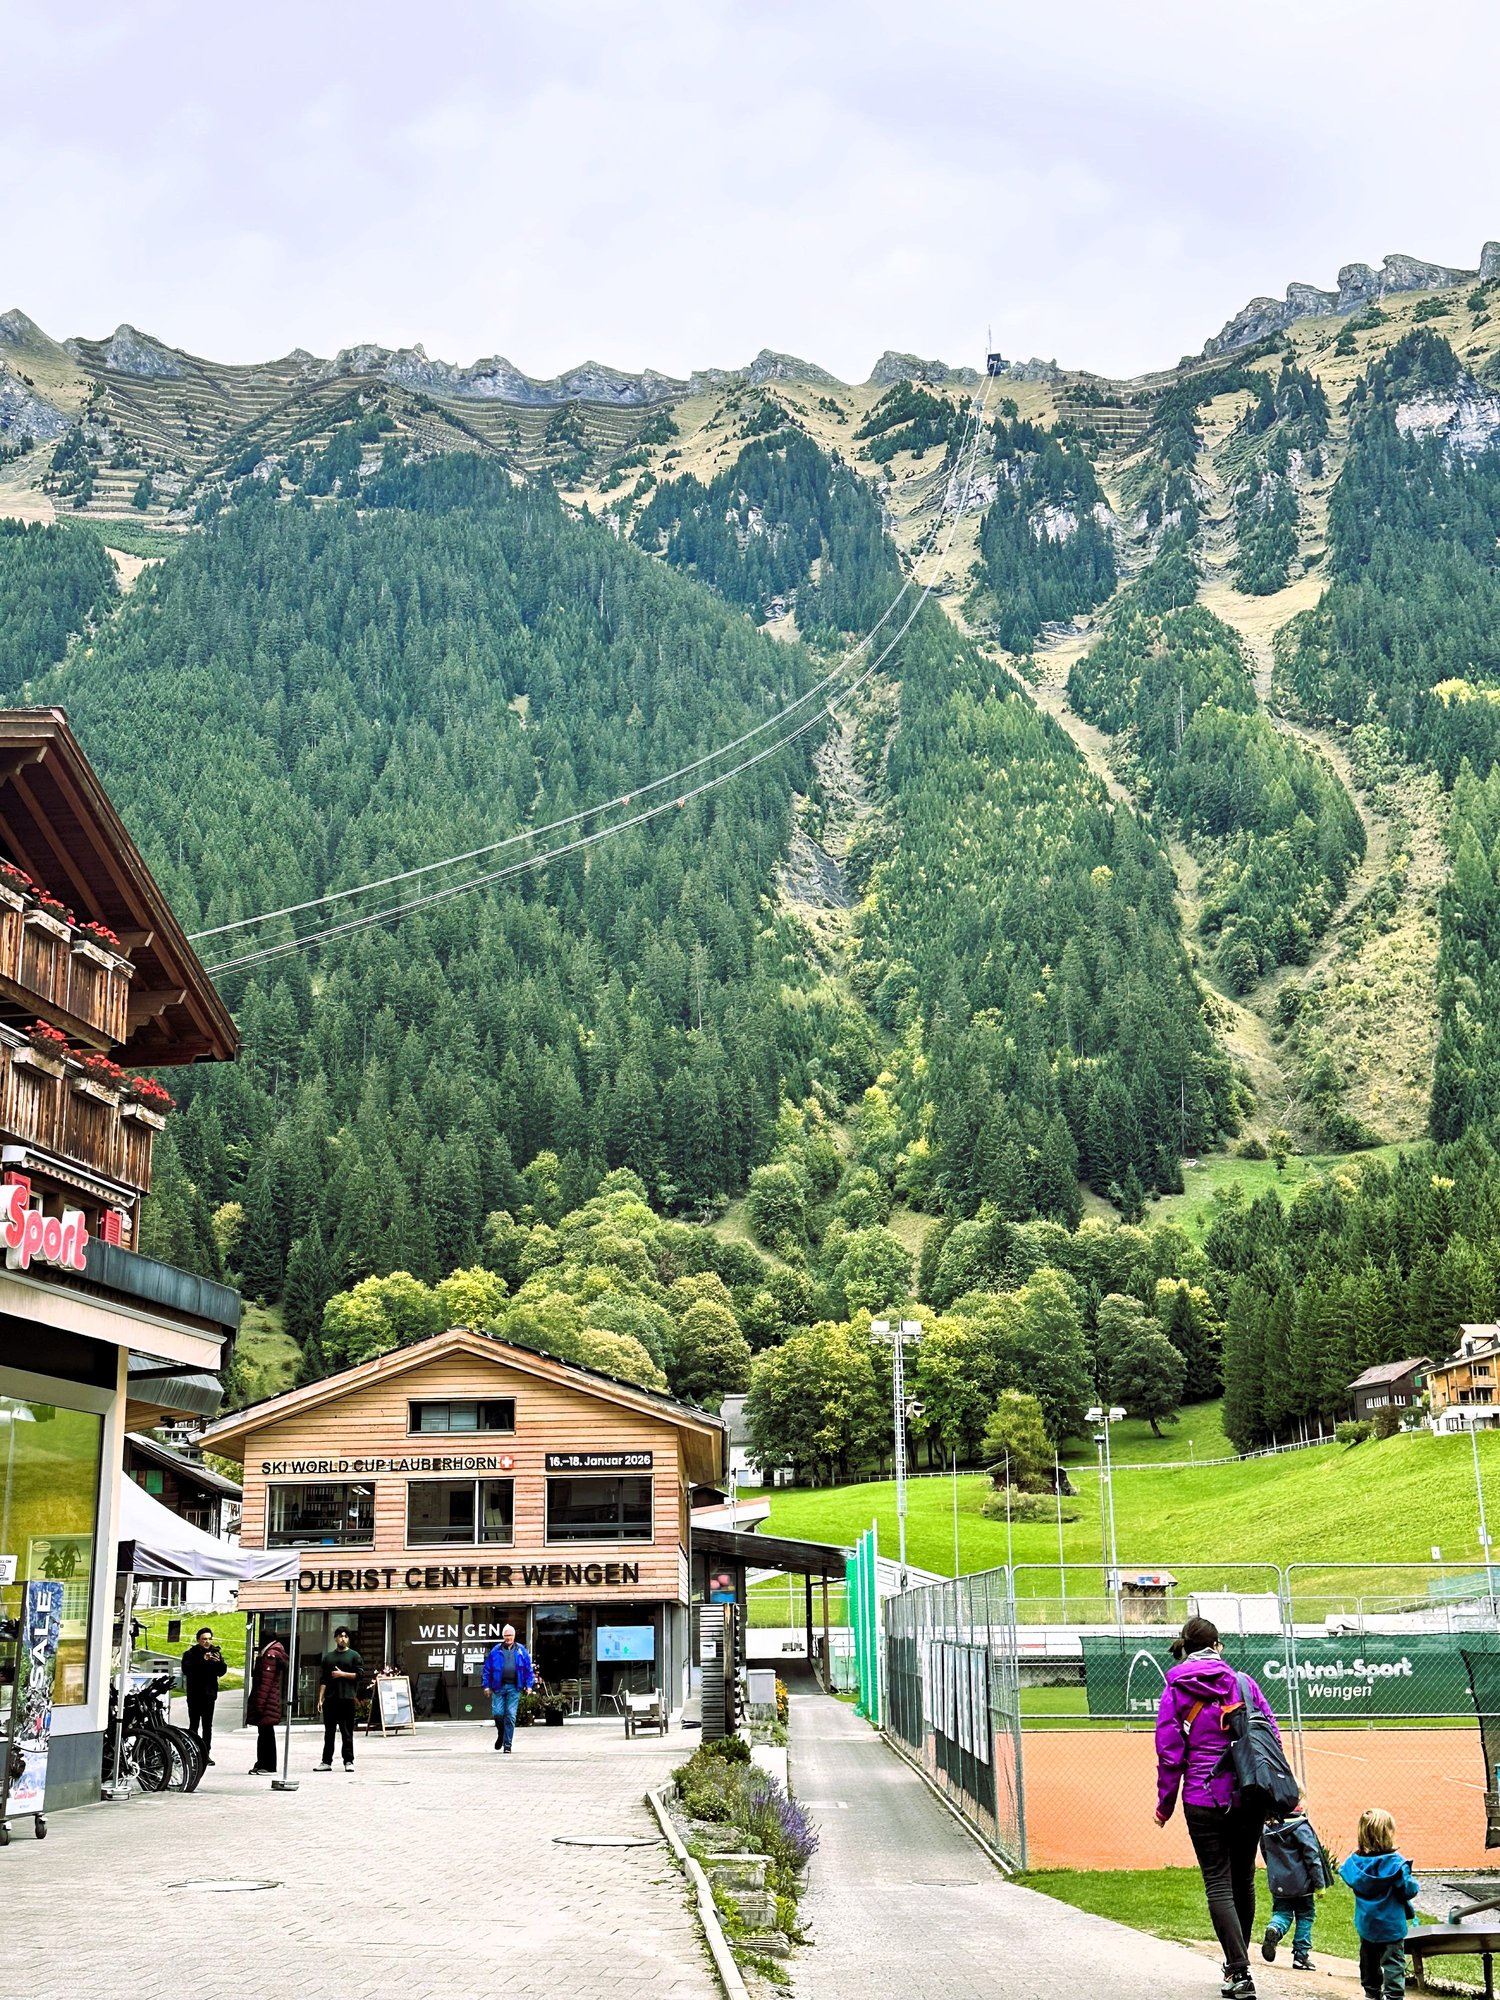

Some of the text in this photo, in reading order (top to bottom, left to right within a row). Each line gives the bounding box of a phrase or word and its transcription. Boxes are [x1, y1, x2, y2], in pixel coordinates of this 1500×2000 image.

[4, 1185, 89, 1271] Sport
[261, 1457, 498, 1475] SKI WORLD CUP LAUBERHORN
[584, 1456, 623, 1466] Januar
[624, 1455, 651, 1465] 2026
[285, 1563, 639, 1592] OURIST CENTER WENGEN
[30, 1591, 52, 1689] SALE
[1263, 1657, 1413, 1684] Central-Sport
[1307, 1683, 1372, 1700] Wengen
